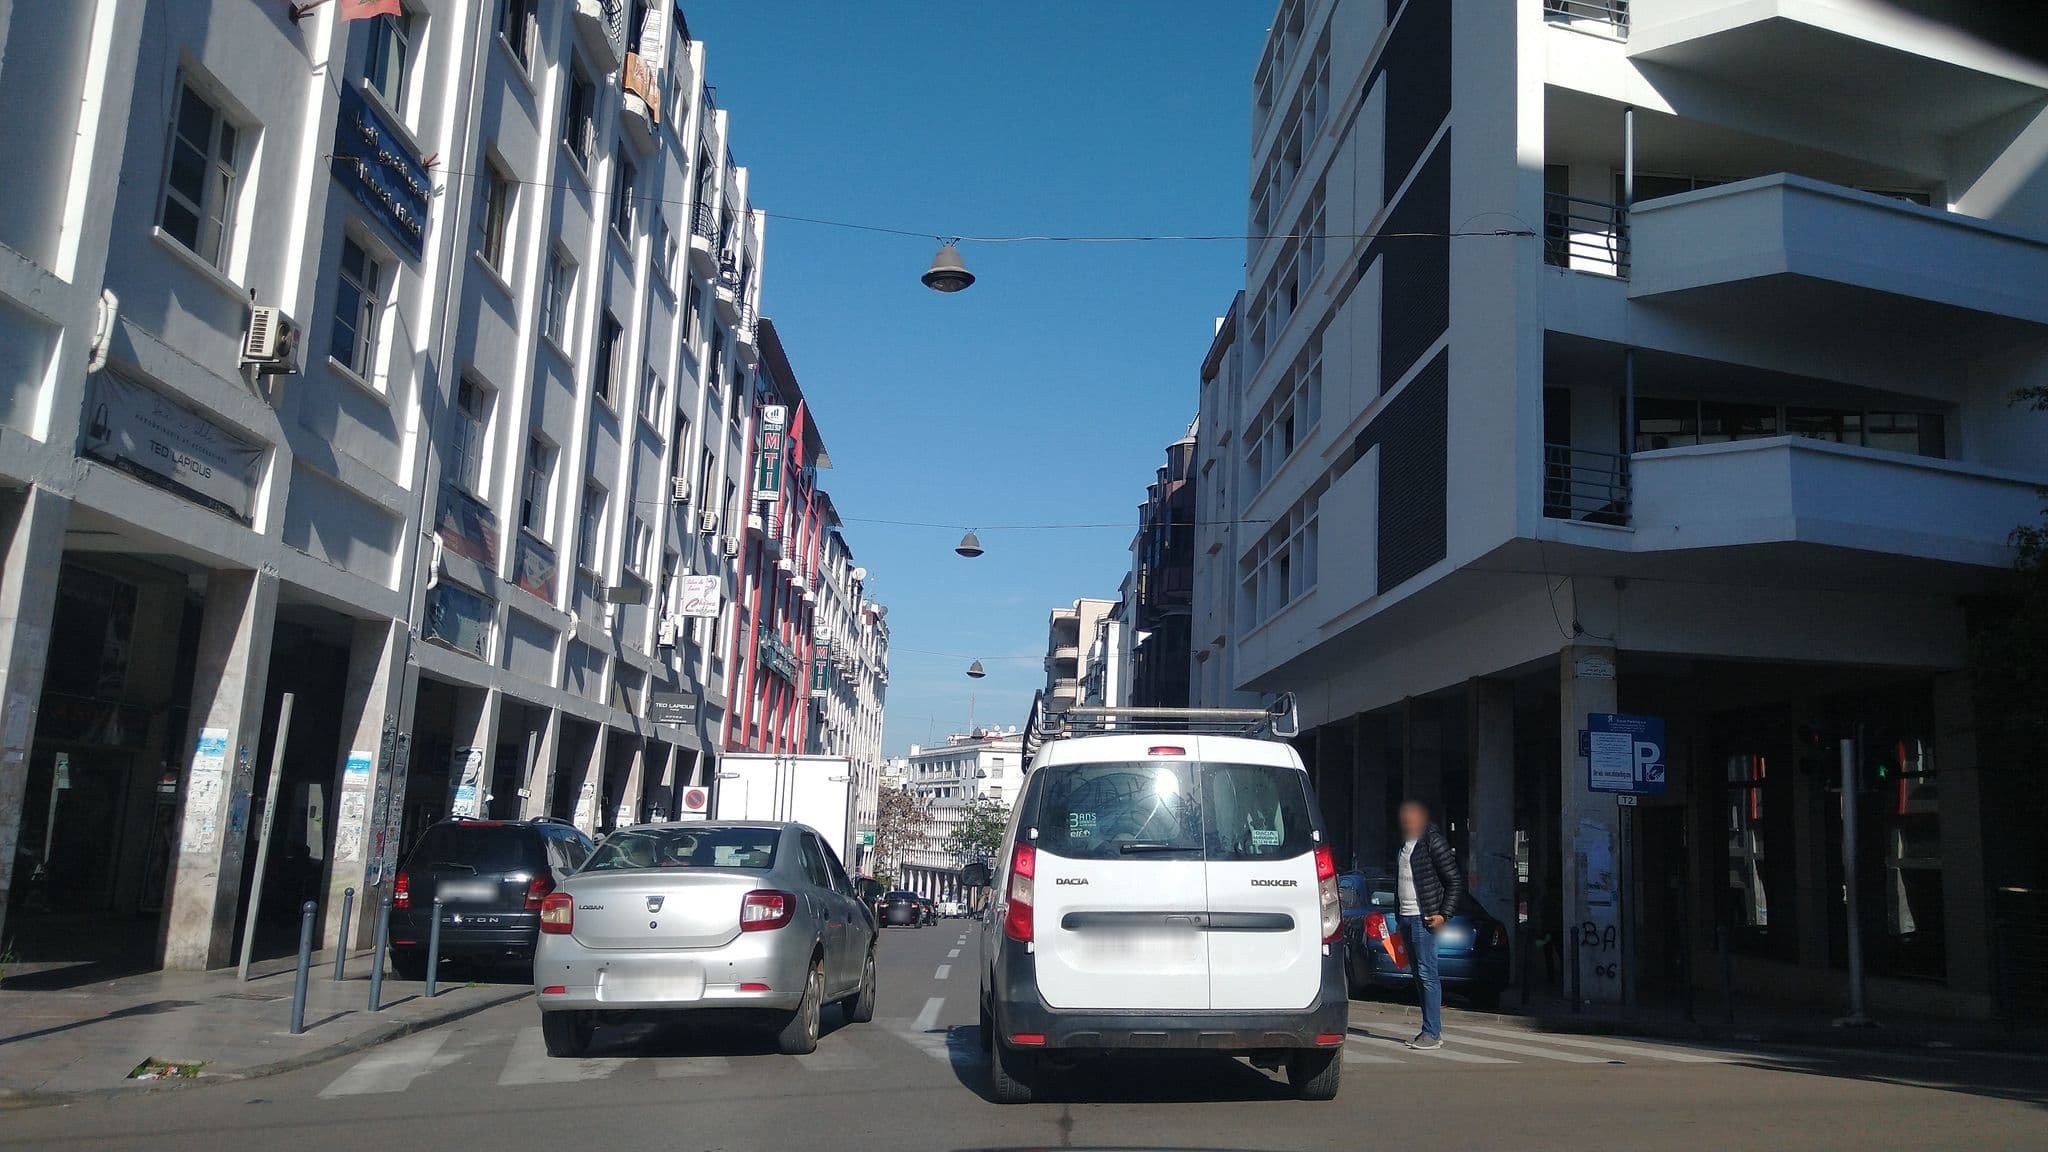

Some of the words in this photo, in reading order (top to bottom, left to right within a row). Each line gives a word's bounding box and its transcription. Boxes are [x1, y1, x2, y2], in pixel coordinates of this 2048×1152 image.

[149, 440, 170, 459] TED
[171, 452, 212, 479] LAPIDUS
[763, 433, 780, 489] MTI
[815, 646, 828, 689] MTI
[1633, 741, 1661, 782] P
[1623, 796, 1634, 804] T2
[1070, 813, 1078, 827] 3
[1251, 879, 1298, 887] DOKKER
